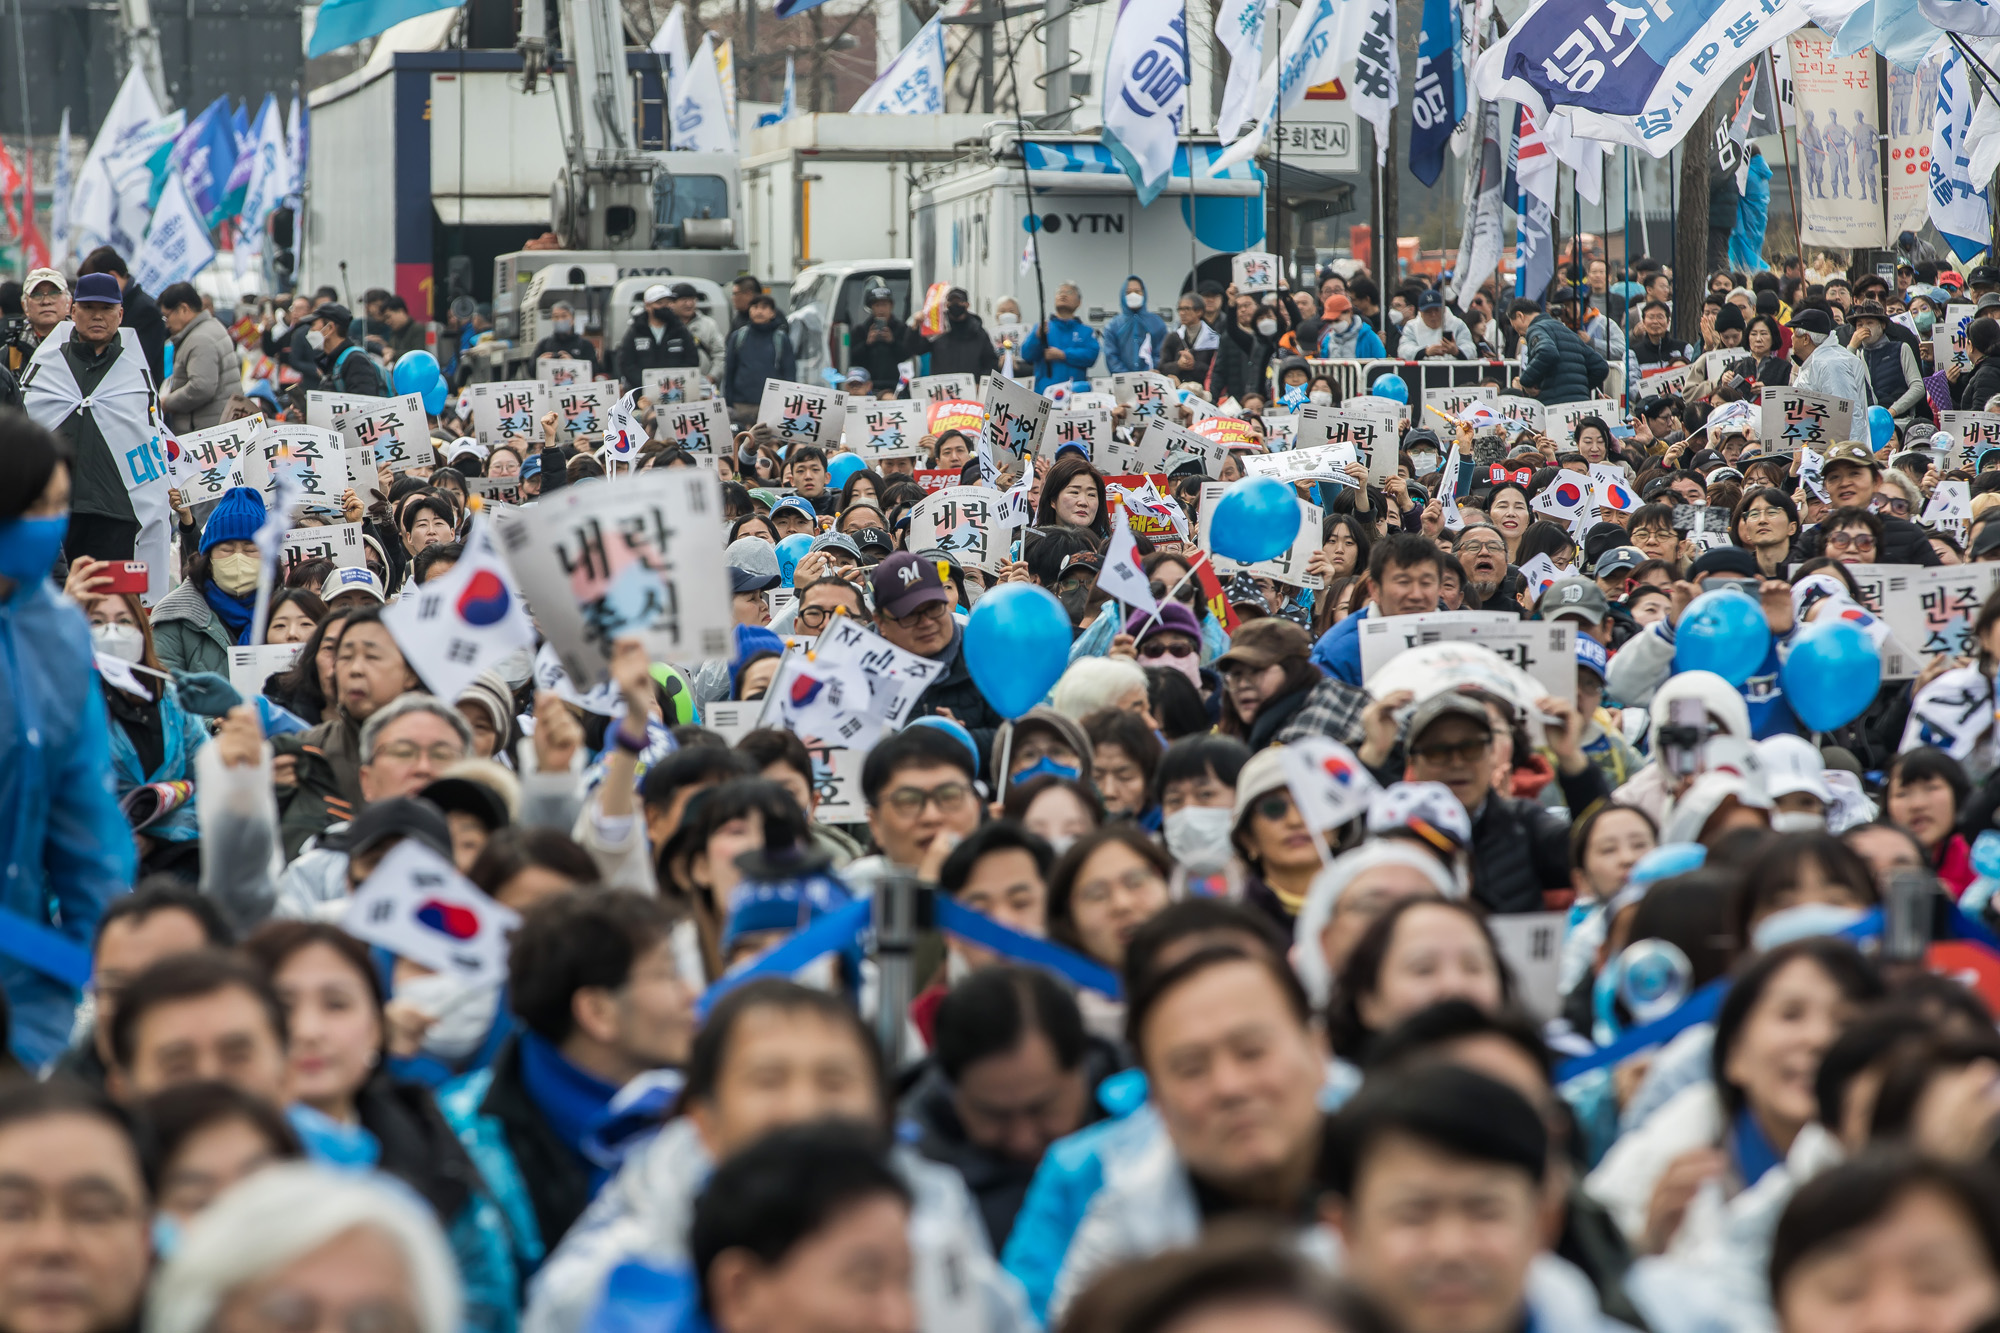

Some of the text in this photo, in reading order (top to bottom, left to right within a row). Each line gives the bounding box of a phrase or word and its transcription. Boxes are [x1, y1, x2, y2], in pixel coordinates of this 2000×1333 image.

[1796, 61, 1838, 75] 그리고
[1842, 71, 1870, 89] 국군
[1272, 127, 1347, 150] 우회전시
[1066, 214, 1124, 233] YTN
[617, 267, 672, 279] KATO
[1950, 334, 1966, 349] 내
[1950, 351, 1968, 369] 종
[657, 376, 686, 390] 내란
[928, 381, 963, 400] 내란
[1134, 380, 1168, 401] 민주
[331, 402, 350, 415] 민
[497, 392, 534, 414] 내란
[561, 393, 600, 415] 민주
[784, 393, 827, 420] 내란
[1127, 402, 1168, 422] 수호
[1503, 400, 1537, 424] 내란
[1783, 398, 1830, 423] 민주
[354, 411, 404, 446] 민주
[497, 416, 534, 438] 종식
[563, 417, 602, 437] 수호
[672, 411, 710, 435] 내란
[777, 417, 822, 442] 종식
[865, 411, 909, 432] 민주
[1056, 419, 1097, 441] 내란
[866, 433, 910, 453] 수호
[1326, 421, 1378, 451] 내란
[1781, 423, 1826, 446] 수호
[1962, 421, 2000, 445] 내란
[191, 434, 245, 465] 내란
[263, 439, 323, 469] 민주
[374, 439, 411, 462] 호
[1959, 445, 1979, 466] 종
[198, 467, 226, 493] 종
[917, 474, 962, 490] 윤석열
[1492, 469, 1531, 485] 파면
[932, 501, 991, 531] 내란
[554, 505, 675, 582] 내란
[863, 529, 878, 543] LA
[898, 561, 921, 585] M
[1921, 586, 1982, 624] 민주
[814, 772, 850, 806] 호
